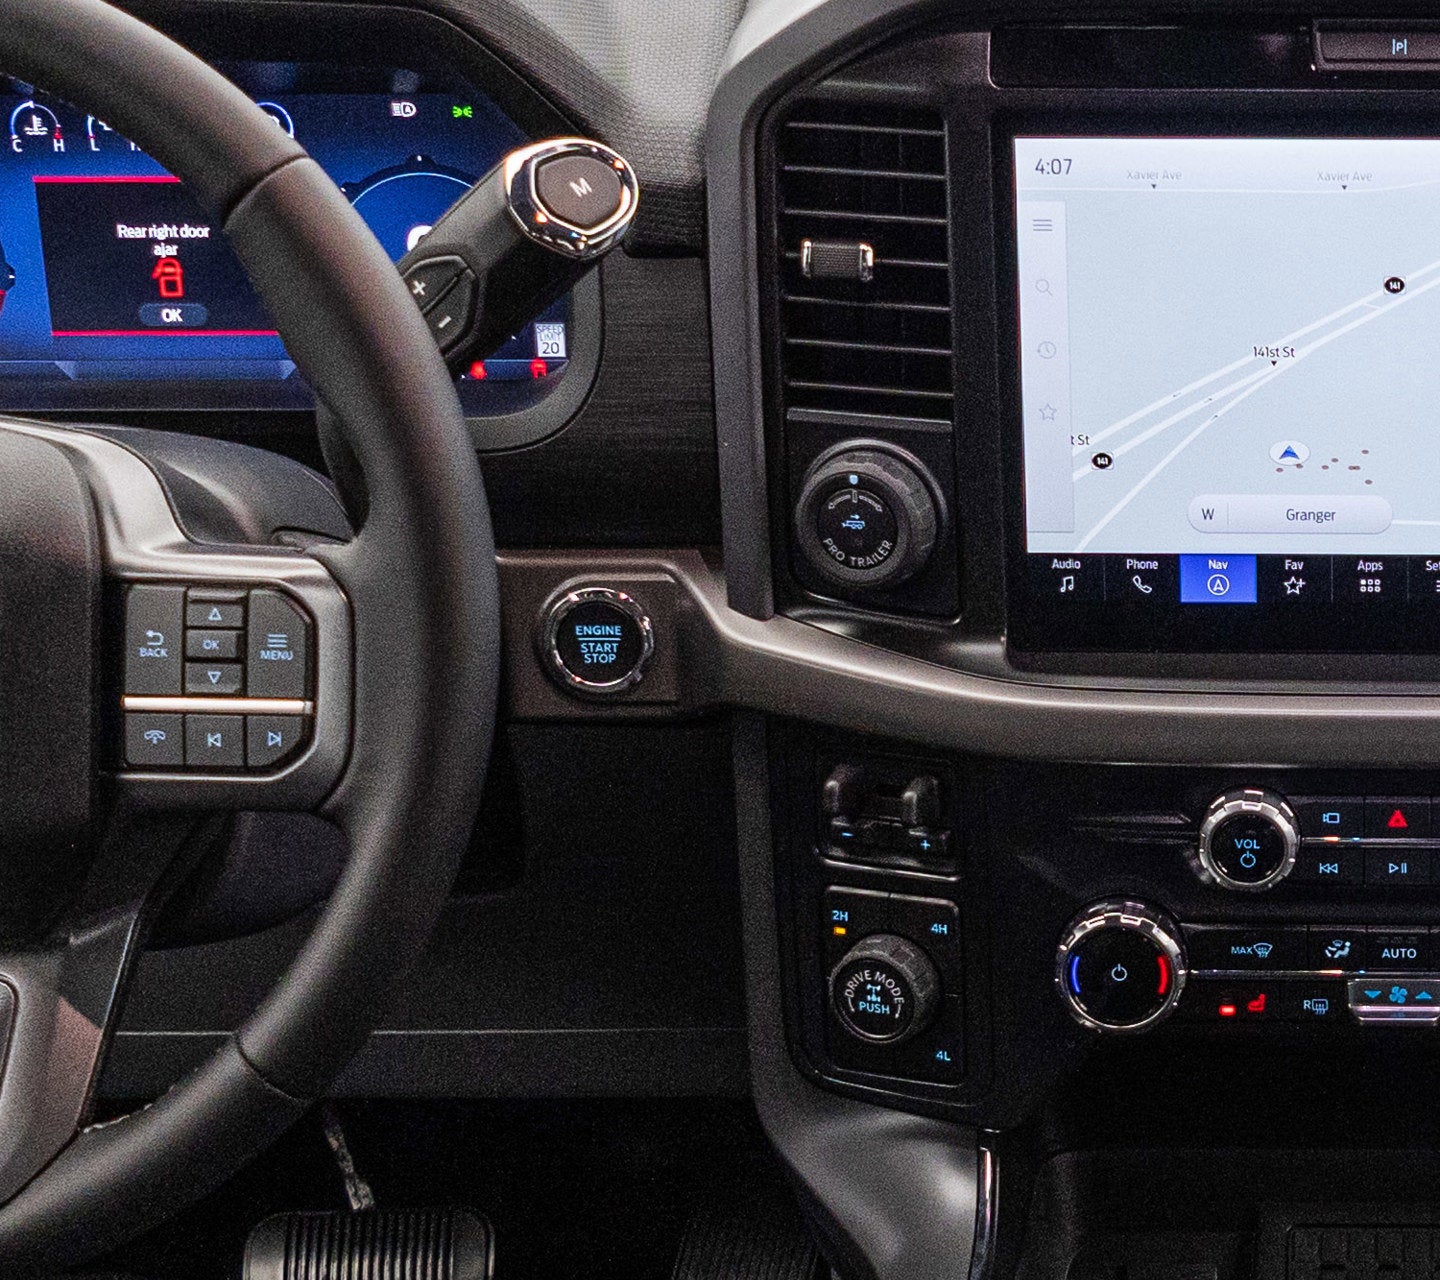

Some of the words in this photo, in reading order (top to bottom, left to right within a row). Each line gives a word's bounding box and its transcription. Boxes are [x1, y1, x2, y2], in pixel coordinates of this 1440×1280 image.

[12, 138, 23, 153] C
[53, 138, 65, 152] H
[90, 139, 101, 151] L
[1035, 159, 1073, 175] 4:07
[1126, 169, 1160, 181] Xavier
[1162, 169, 1182, 181] Ave
[1317, 171, 1350, 183] Xavier
[1352, 171, 1373, 182] Ave
[569, 177, 594, 198] M
[116, 224, 147, 238] Rear
[148, 223, 179, 240] right
[179, 223, 210, 238] door
[153, 242, 178, 258] ajar
[161, 308, 183, 323] OK
[542, 341, 560, 355] 20
[1253, 346, 1280, 358] 141st
[1282, 346, 1295, 358] St
[1077, 434, 1090, 446] St
[1201, 508, 1215, 520] W
[1286, 508, 1336, 523] Granger
[823, 538, 845, 561] PRO
[850, 539, 893, 567] TRAILER
[1051, 559, 1081, 570] Audio
[1126, 559, 1158, 570] Phone
[1208, 559, 1229, 570] Nav
[1285, 560, 1304, 570] Fav
[1357, 560, 1383, 573] Apps
[575, 624, 622, 636] ENGINE
[202, 640, 220, 650] OK
[580, 642, 618, 653] START
[139, 648, 168, 658] BACK
[260, 649, 294, 661] MENU
[584, 653, 617, 663] STOP
[1235, 838, 1260, 850] VOL
[832, 910, 849, 921] 2H
[931, 923, 948, 935] 4H
[1231, 946, 1253, 955] MAX
[1382, 948, 1417, 959] AUTO
[844, 970, 872, 998] DRIVE
[874, 971, 905, 1004] MODE
[859, 1001, 890, 1014] PUSH
[936, 1051, 951, 1062] 4L
